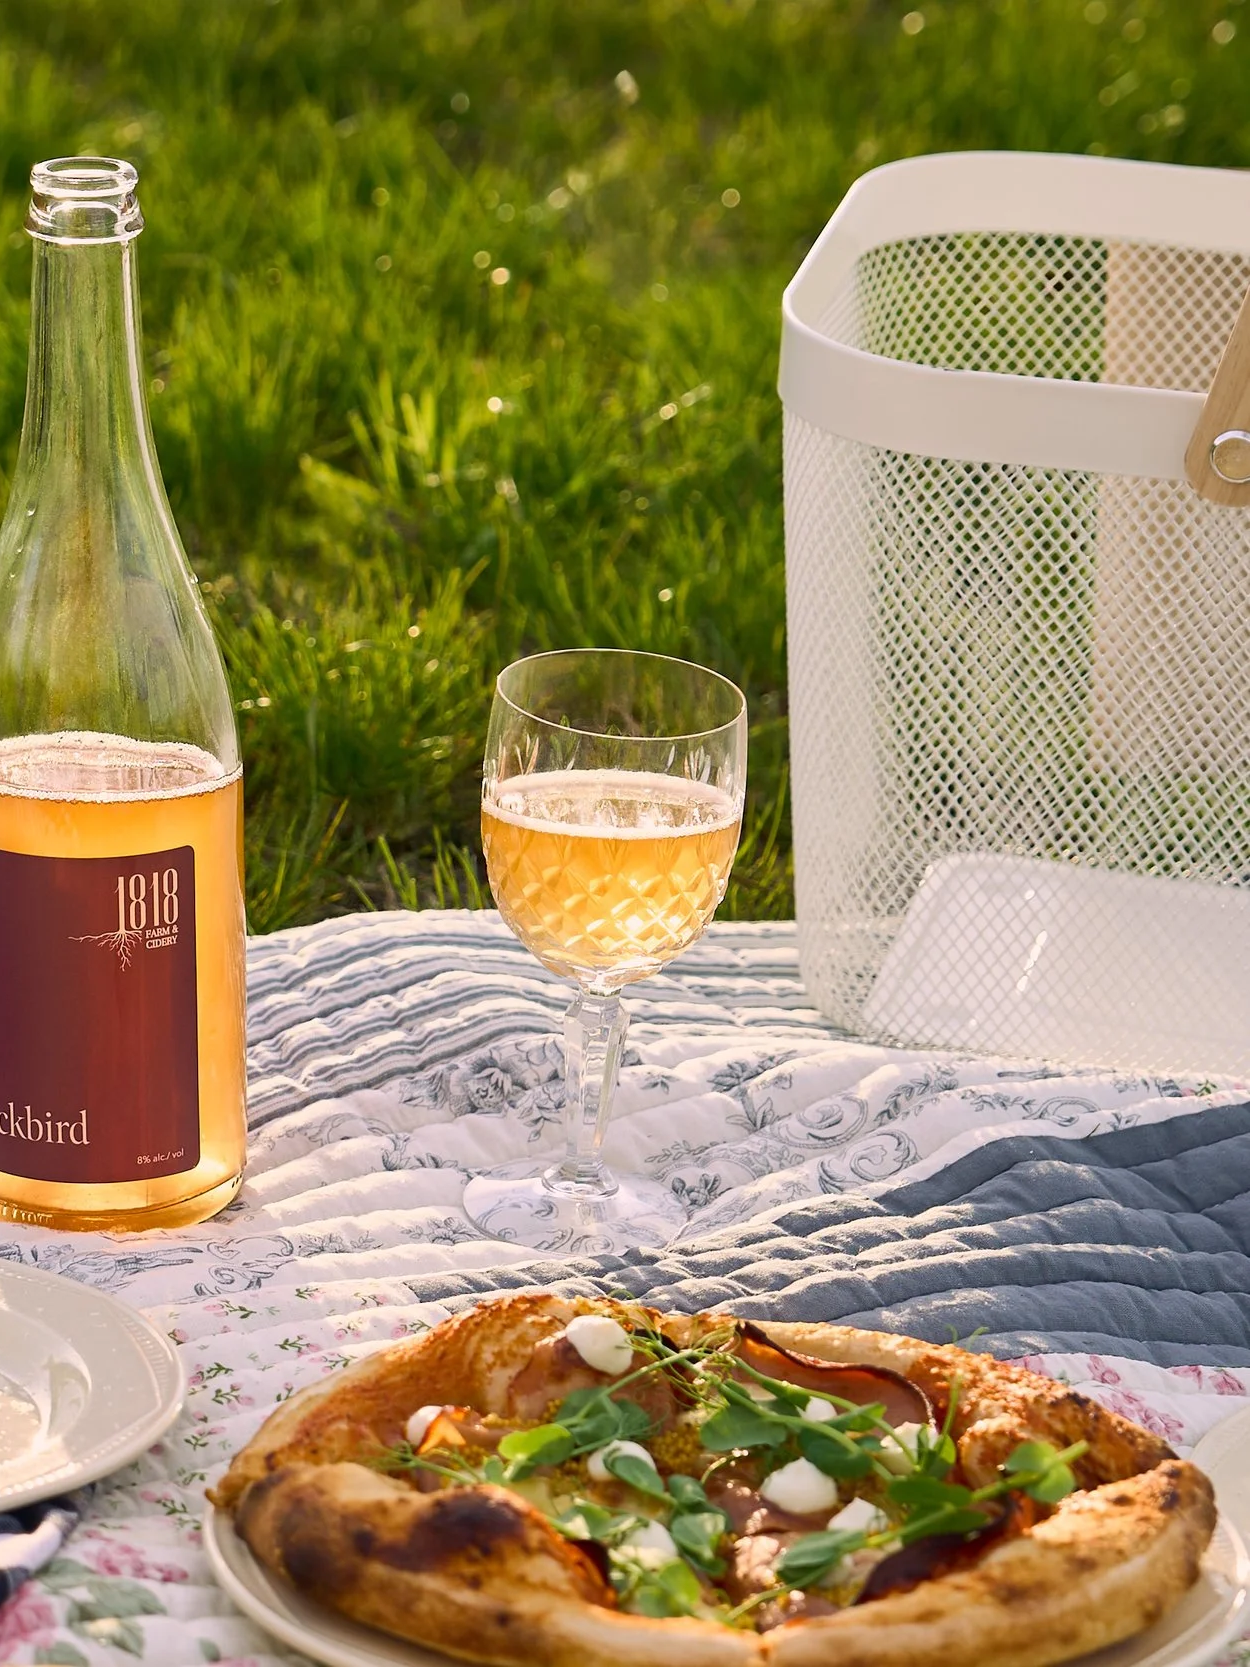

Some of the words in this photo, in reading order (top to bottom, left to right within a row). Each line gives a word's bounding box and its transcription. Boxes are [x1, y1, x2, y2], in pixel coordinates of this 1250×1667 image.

[115, 868, 178, 932] 1818
[145, 927, 170, 938] FARM
[172, 924, 178, 934] &
[146, 935, 178, 949] CIDERY
[137, 1155, 151, 1164] 8%
[172, 1147, 184, 1159] vol
